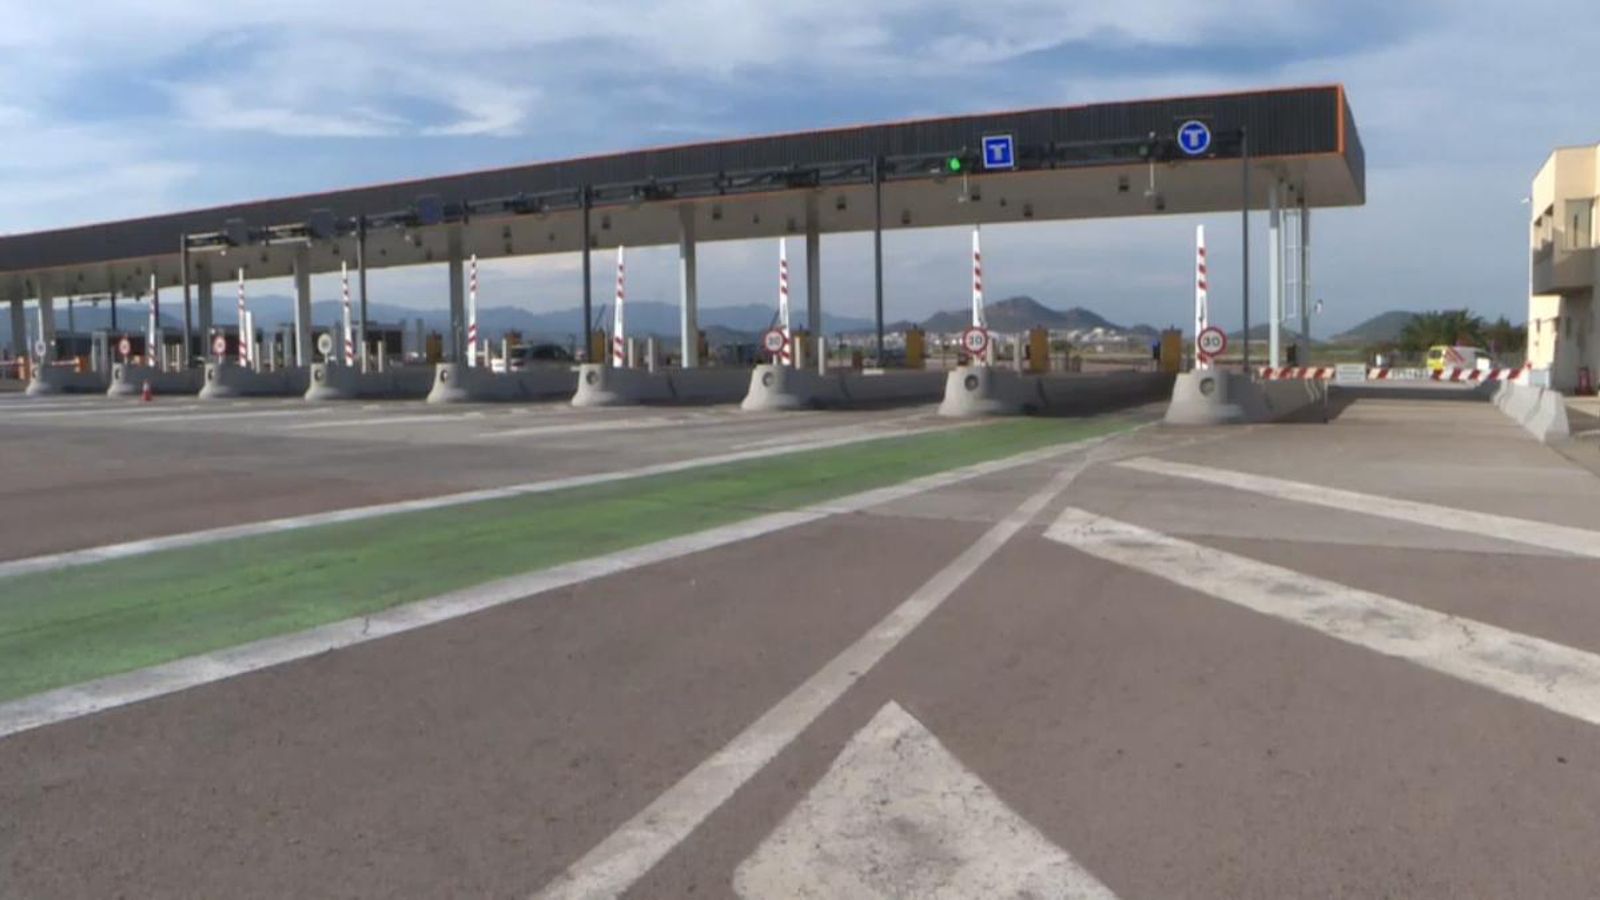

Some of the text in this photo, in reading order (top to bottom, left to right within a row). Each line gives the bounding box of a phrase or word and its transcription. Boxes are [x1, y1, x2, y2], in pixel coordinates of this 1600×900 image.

[1184, 130, 1204, 147] T
[989, 144, 1007, 160] T
[1203, 336, 1220, 347] 30
